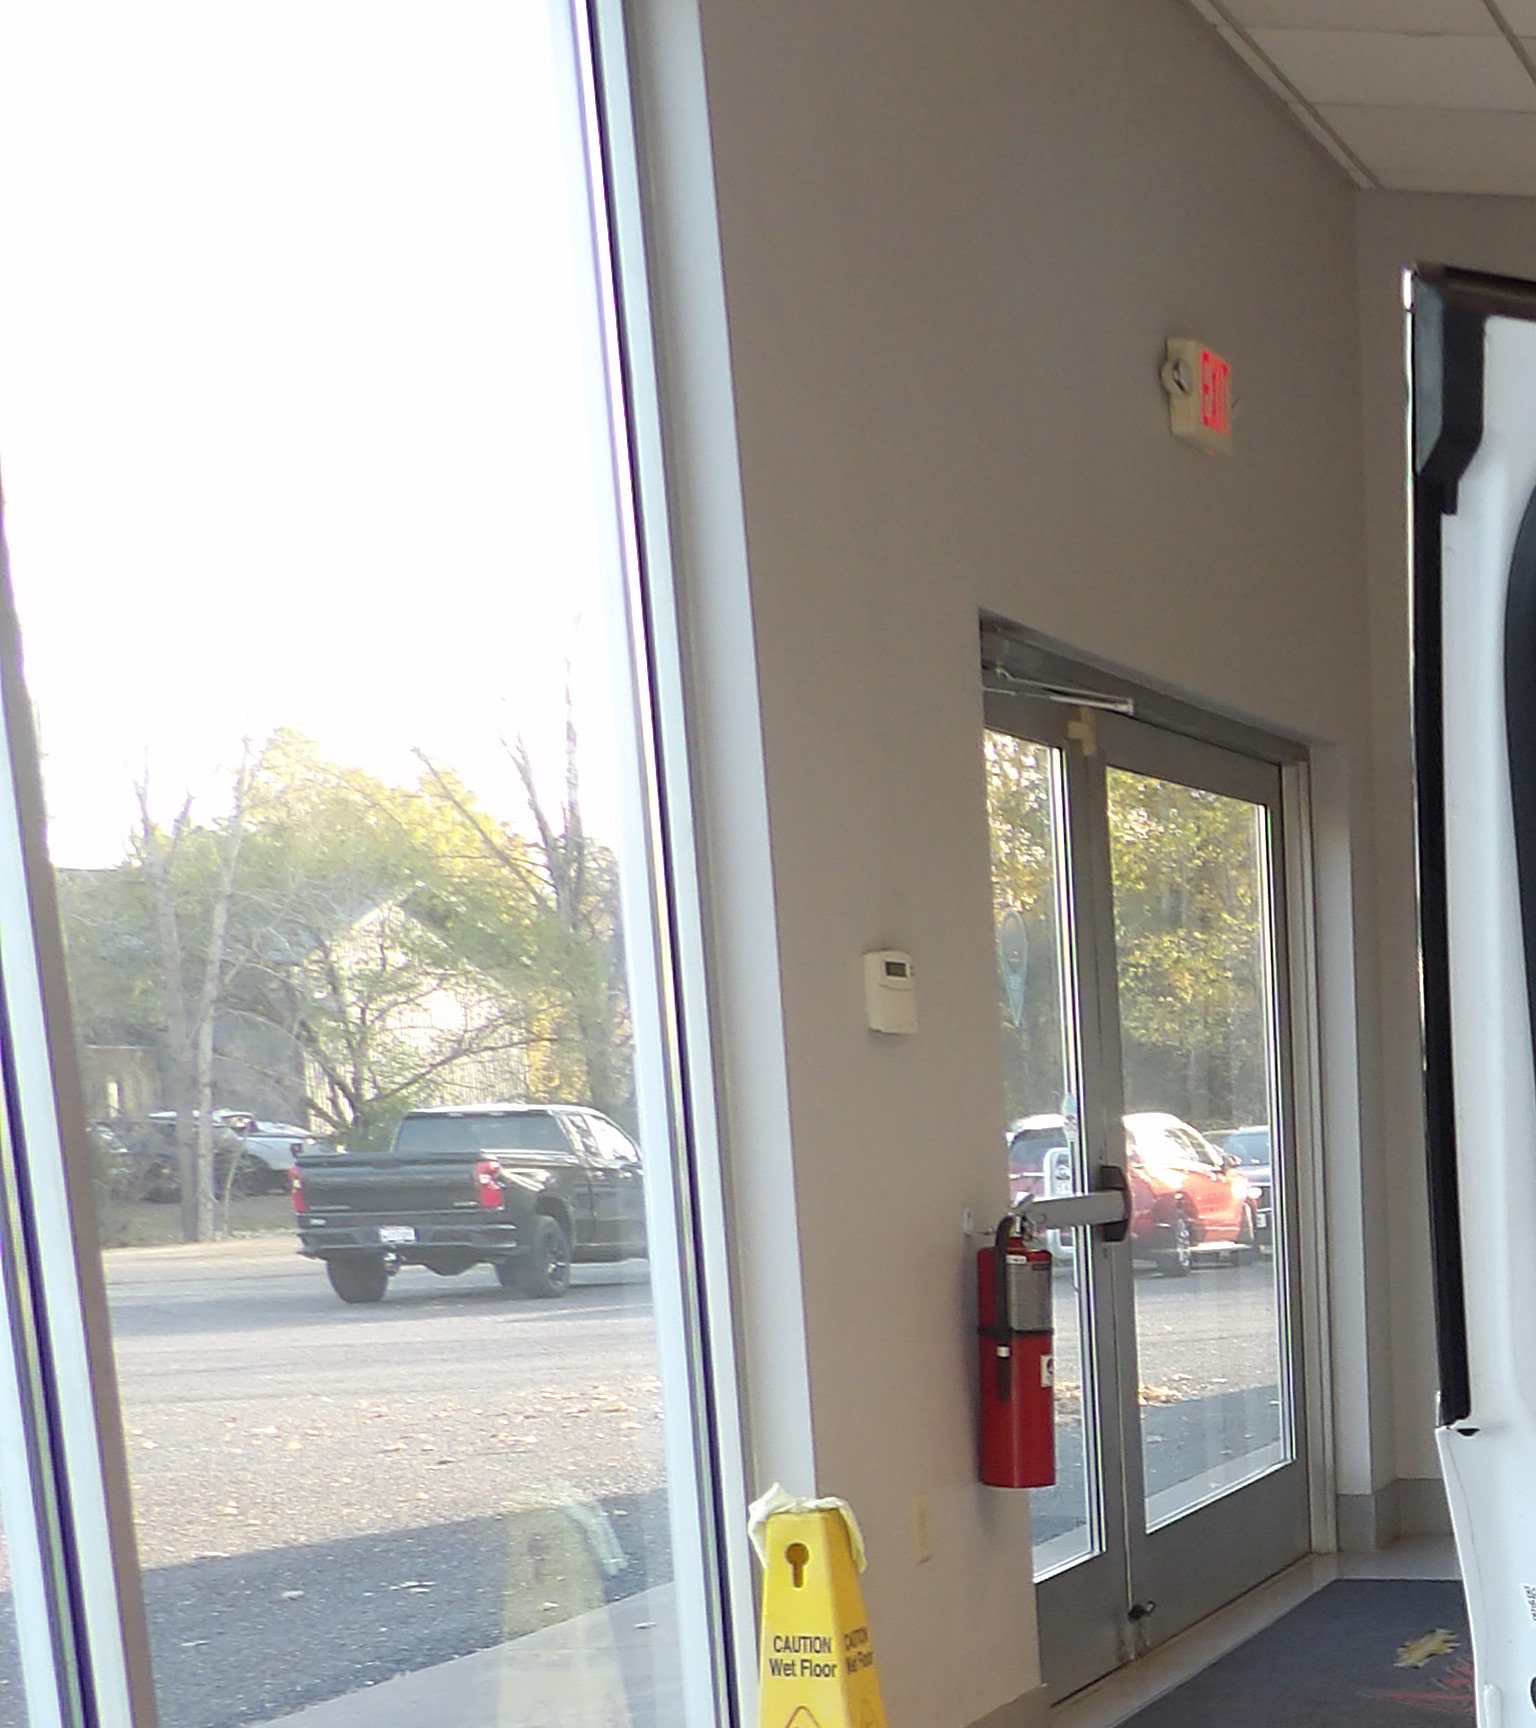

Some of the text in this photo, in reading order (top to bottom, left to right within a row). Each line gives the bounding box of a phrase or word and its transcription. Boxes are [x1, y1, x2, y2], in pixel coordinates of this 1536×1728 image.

[773, 1635, 832, 1653] CAUTION
[769, 1658, 838, 1678] Wet Floor
